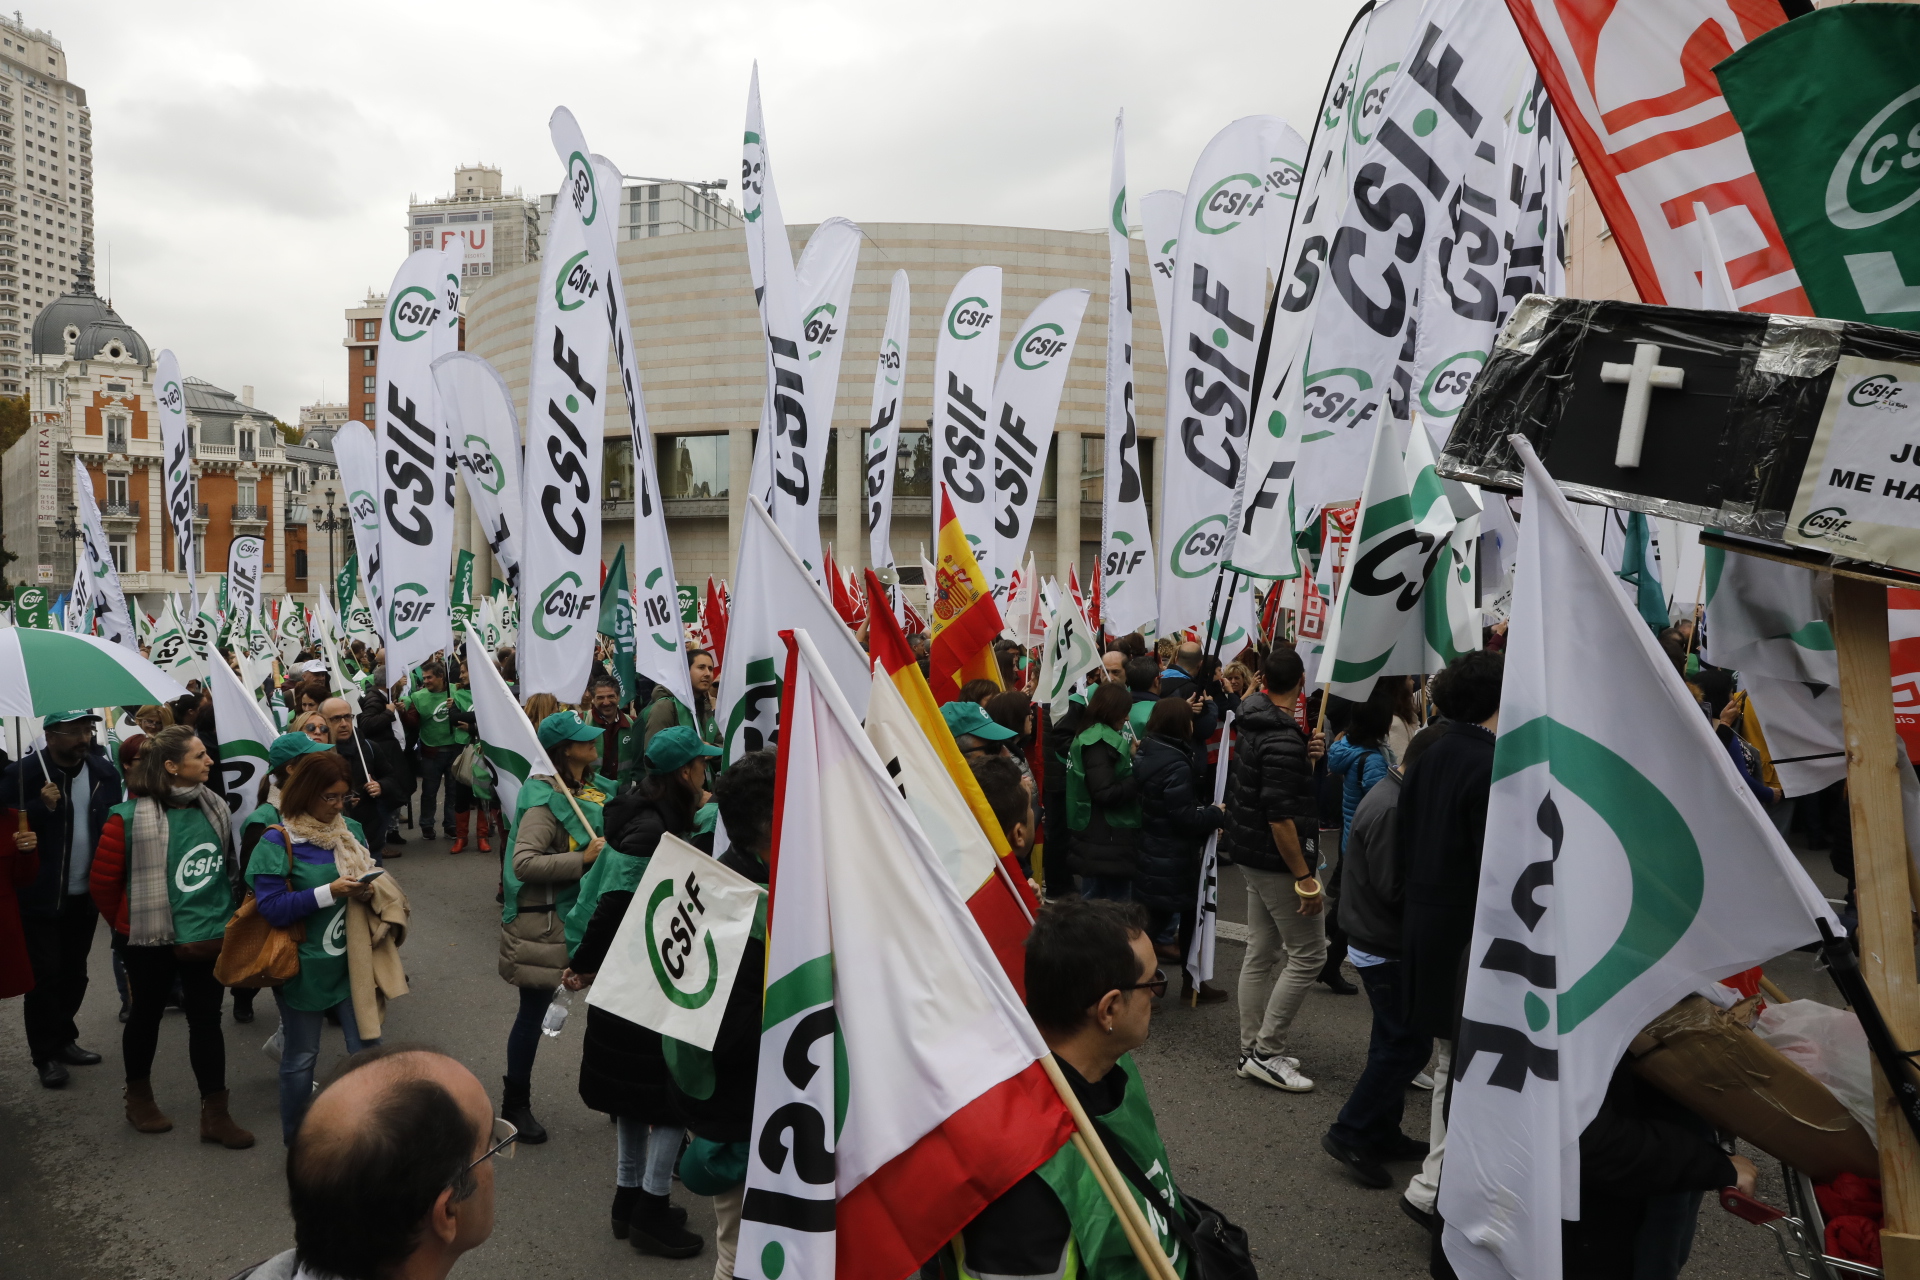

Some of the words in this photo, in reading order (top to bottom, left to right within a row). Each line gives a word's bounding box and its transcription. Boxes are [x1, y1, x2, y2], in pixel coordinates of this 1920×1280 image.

[398, 301, 441, 327] CSIF
[956, 309, 993, 329] CSIF
[1025, 336, 1067, 358] CSIF
[943, 370, 987, 504] CSIF
[39, 428, 49, 478] RETRA
[384, 380, 436, 546] CSIF
[1828, 468, 1875, 493] ME
[240, 543, 260, 554] CSIF
[24, 595, 44, 603] CSIF
